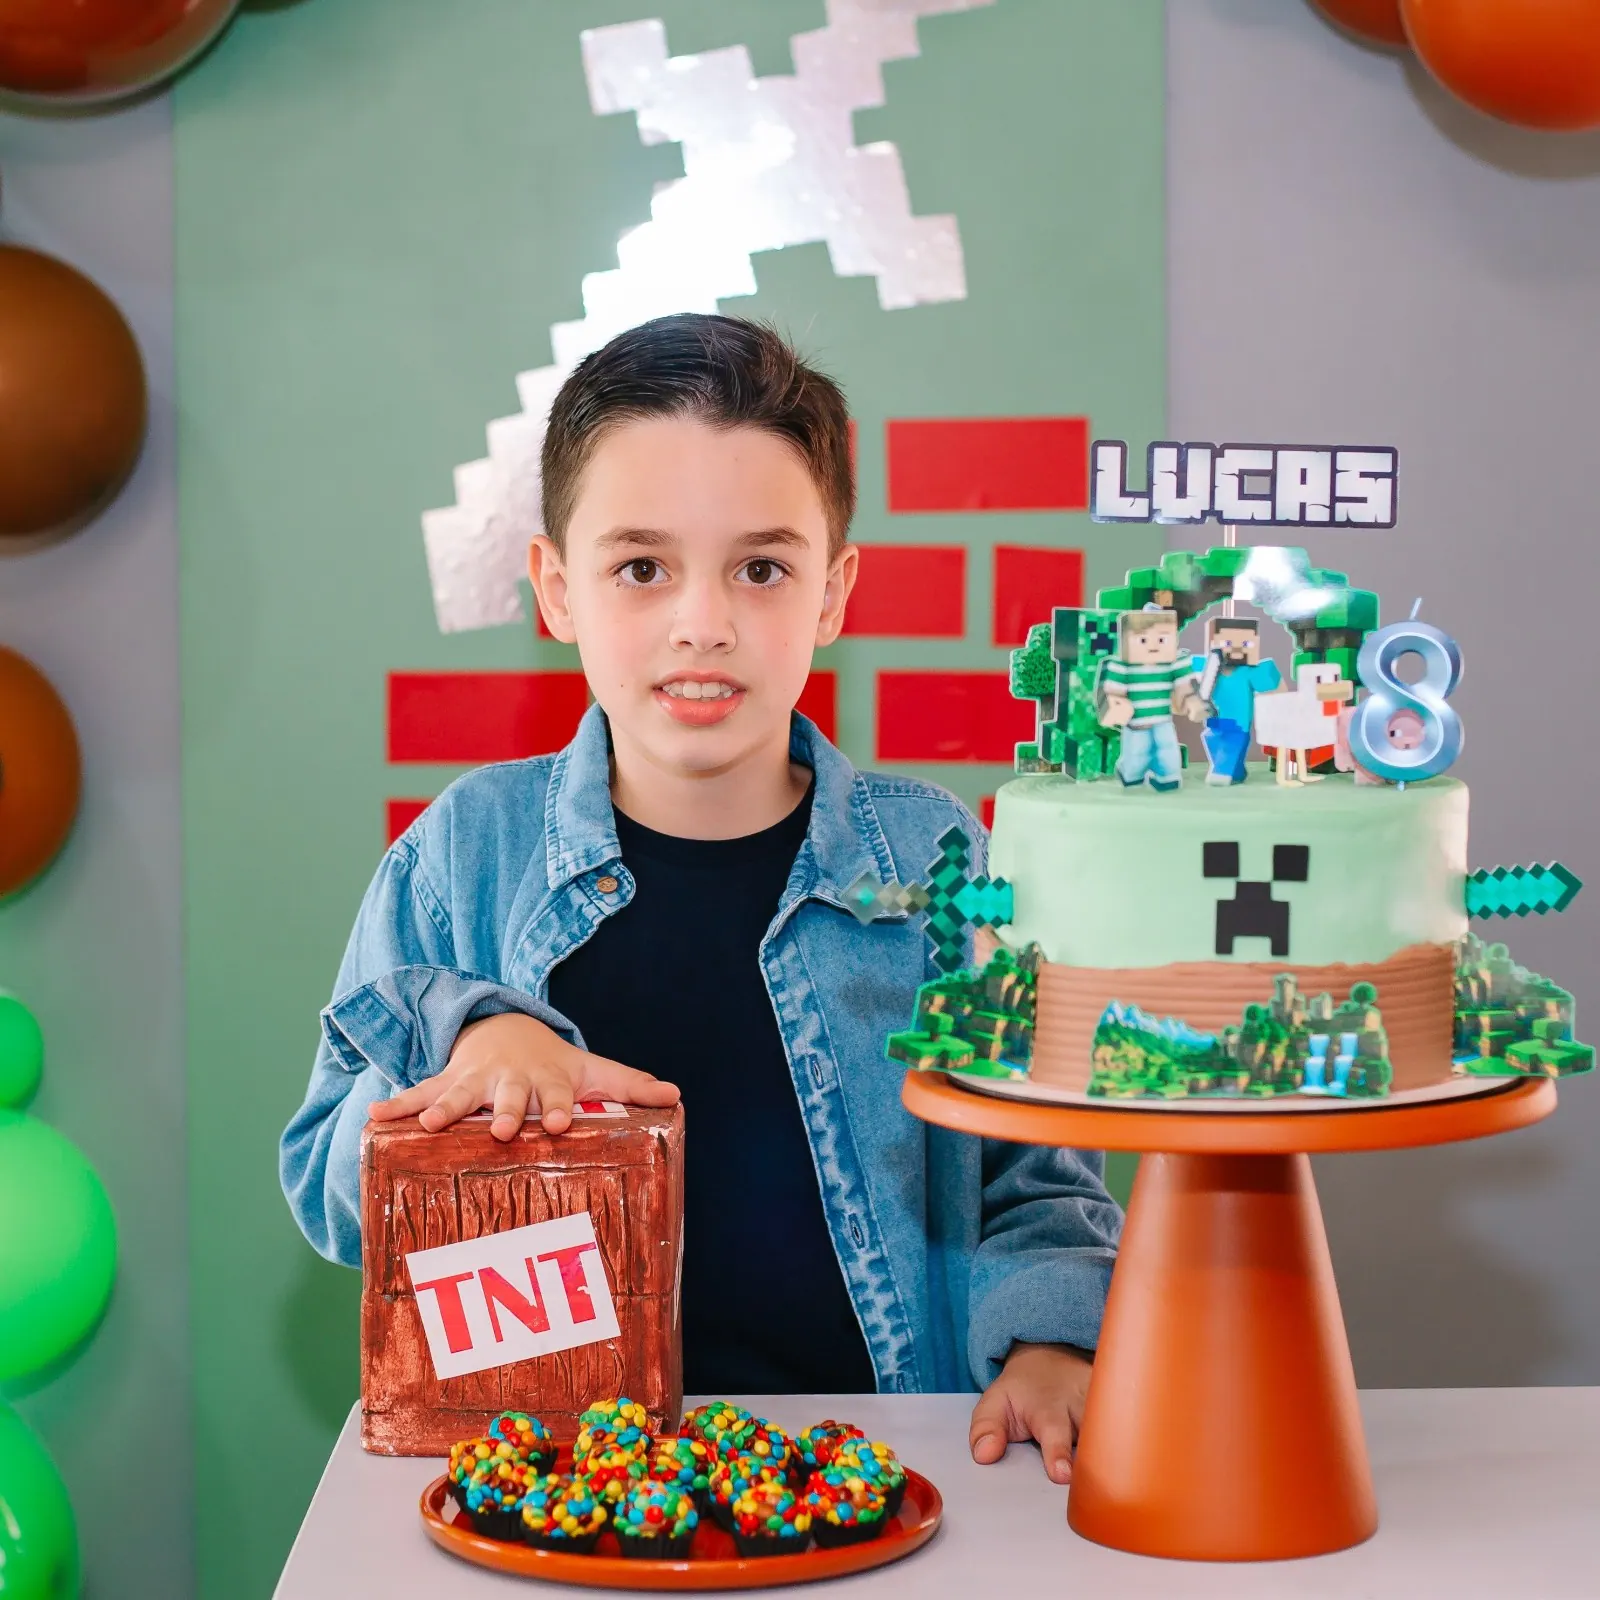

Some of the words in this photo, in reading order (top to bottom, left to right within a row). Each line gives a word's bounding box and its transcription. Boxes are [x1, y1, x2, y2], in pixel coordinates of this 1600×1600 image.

[1093, 443, 1395, 525] LUCAS
[1347, 621, 1465, 782] 8
[414, 1241, 597, 1354] TNT
